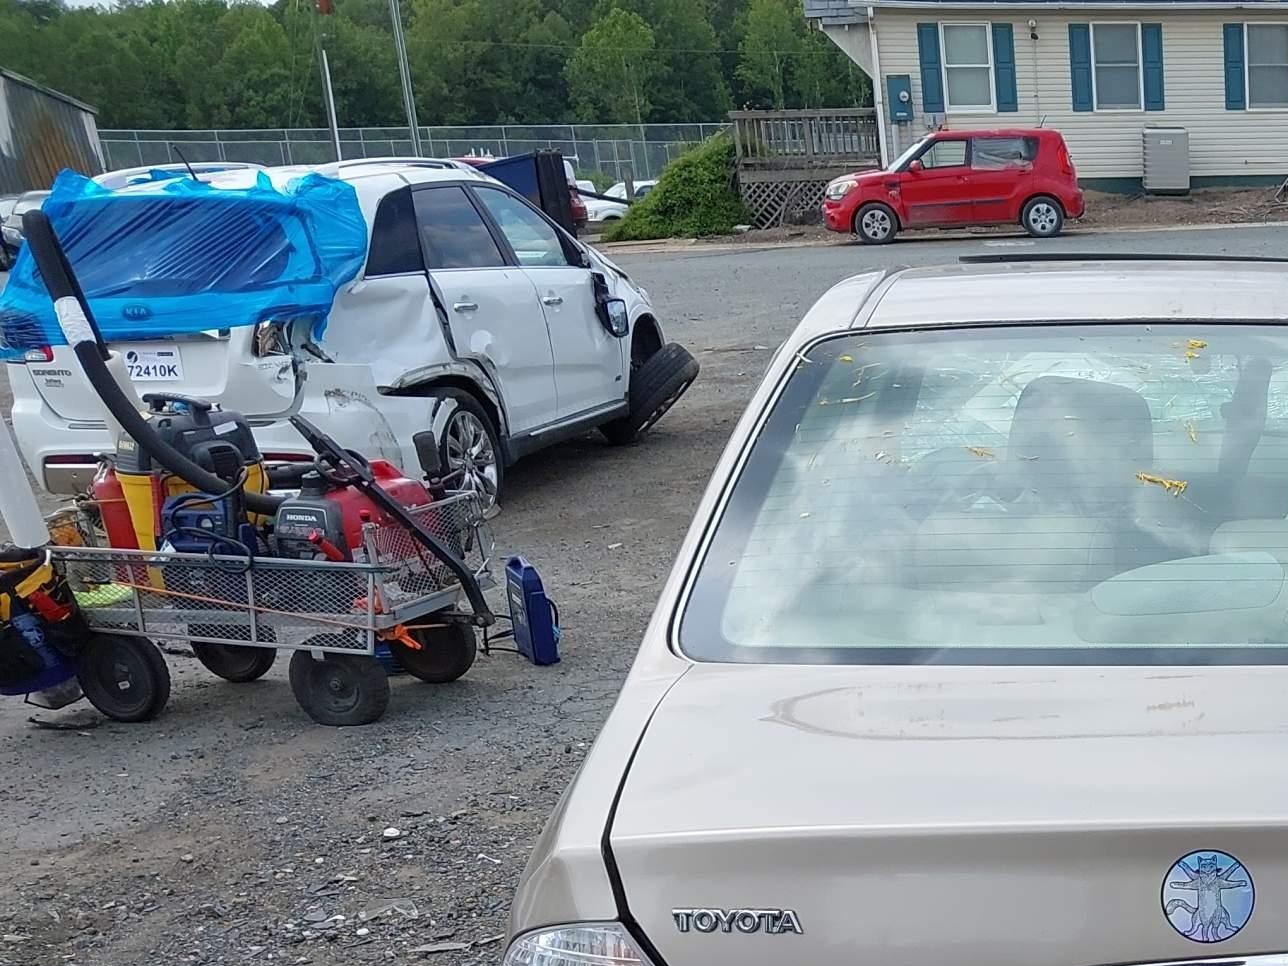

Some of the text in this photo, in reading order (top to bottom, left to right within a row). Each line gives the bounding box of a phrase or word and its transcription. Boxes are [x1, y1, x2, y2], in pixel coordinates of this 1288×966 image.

[127, 365, 178, 377] 72410K
[286, 513, 318, 522] HONDA
[671, 907, 804, 935] TOYOTA
